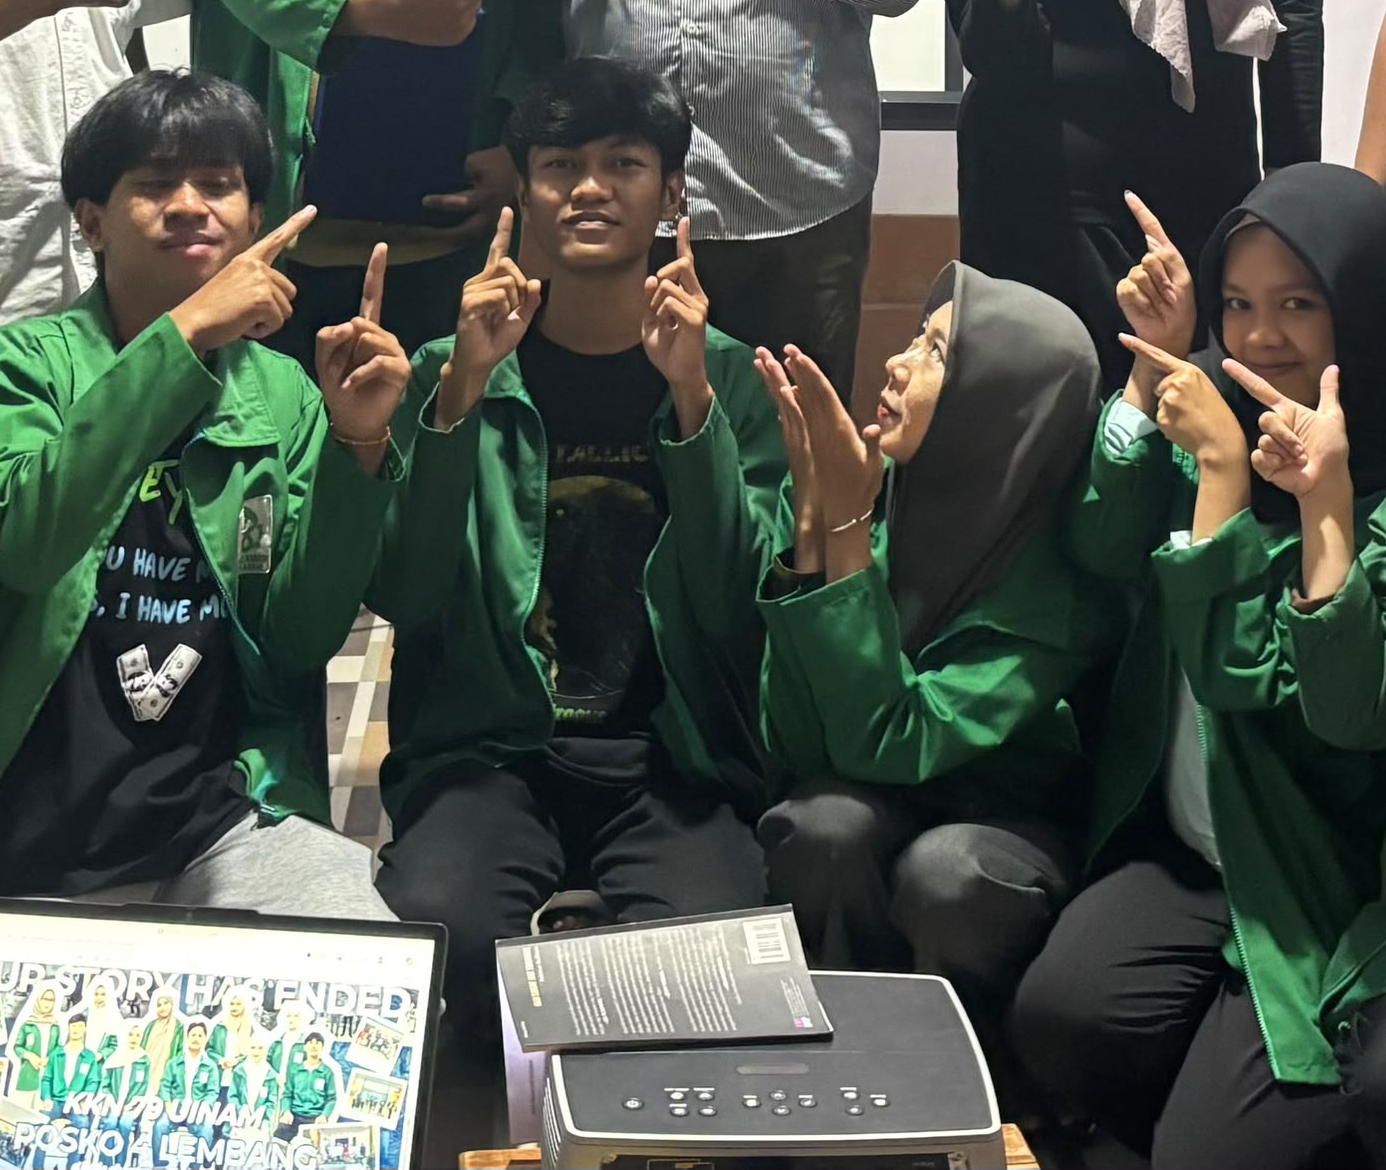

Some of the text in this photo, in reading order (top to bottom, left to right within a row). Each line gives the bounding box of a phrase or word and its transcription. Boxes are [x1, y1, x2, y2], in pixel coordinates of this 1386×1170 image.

[132, 547, 192, 582] HAVE
[137, 594, 193, 624] HAVE
[56, 965, 180, 1002] STORY
[185, 973, 263, 1010] HAS
[273, 980, 413, 1019] ENDED
[63, 1091, 124, 1118] KKN
[166, 1098, 267, 1130] UINAM
[14, 1122, 125, 1158] POSKO
[159, 1134, 318, 1169] LEMBANG
